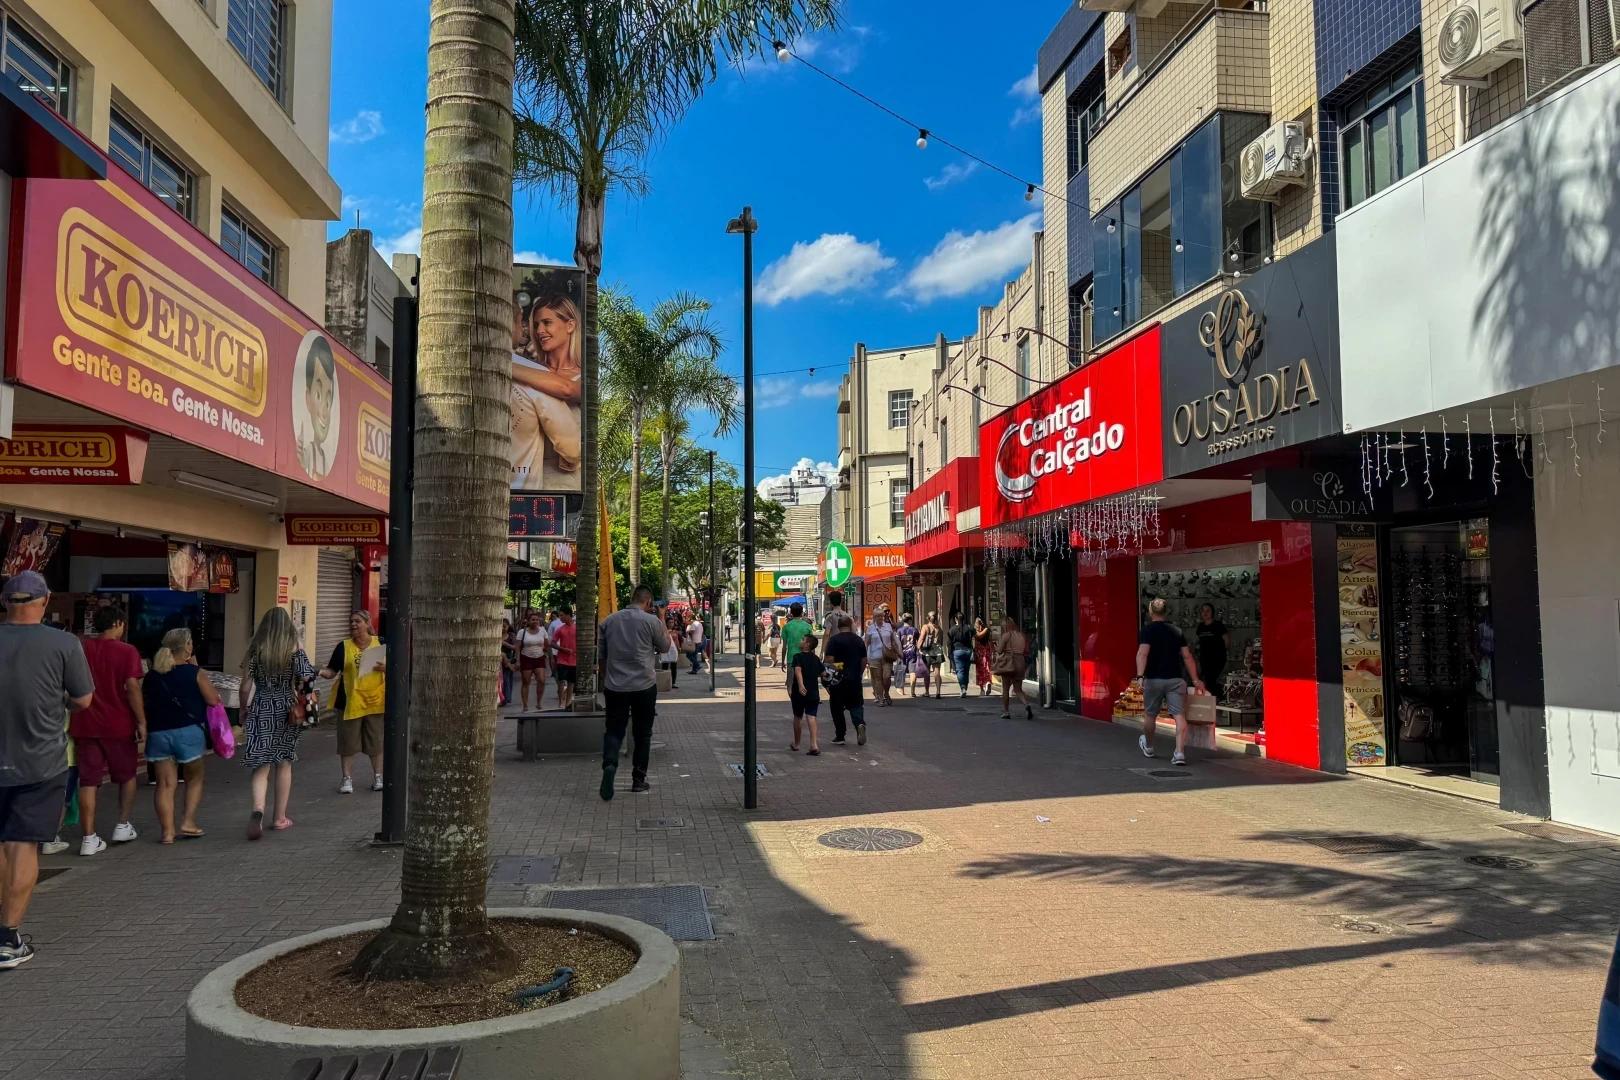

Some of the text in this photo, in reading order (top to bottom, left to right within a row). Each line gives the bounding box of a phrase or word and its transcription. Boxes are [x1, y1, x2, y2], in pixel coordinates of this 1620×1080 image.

[78, 244, 258, 392] KOERICH
[53, 334, 265, 446] Gente Boa. Gente Nossa.
[1173, 358, 1320, 445] OUSADIA
[1020, 386, 1091, 447] Central
[1064, 426, 1078, 441] do
[1207, 425, 1277, 456] acessórios
[1031, 421, 1125, 478] Calçado
[29, 467, 71, 476] Gente
[73, 467, 119, 477] Nossa.
[1291, 498, 1369, 515] OUSADIA
[299, 522, 373, 532] KOERICH
[864, 553, 904, 568] FARMÁCIA
[1342, 575, 1376, 583] Aneis
[866, 584, 889, 593] DES
[865, 593, 892, 603] CON
[1342, 609, 1378, 617] Piercing
[1344, 647, 1379, 656] Colar
